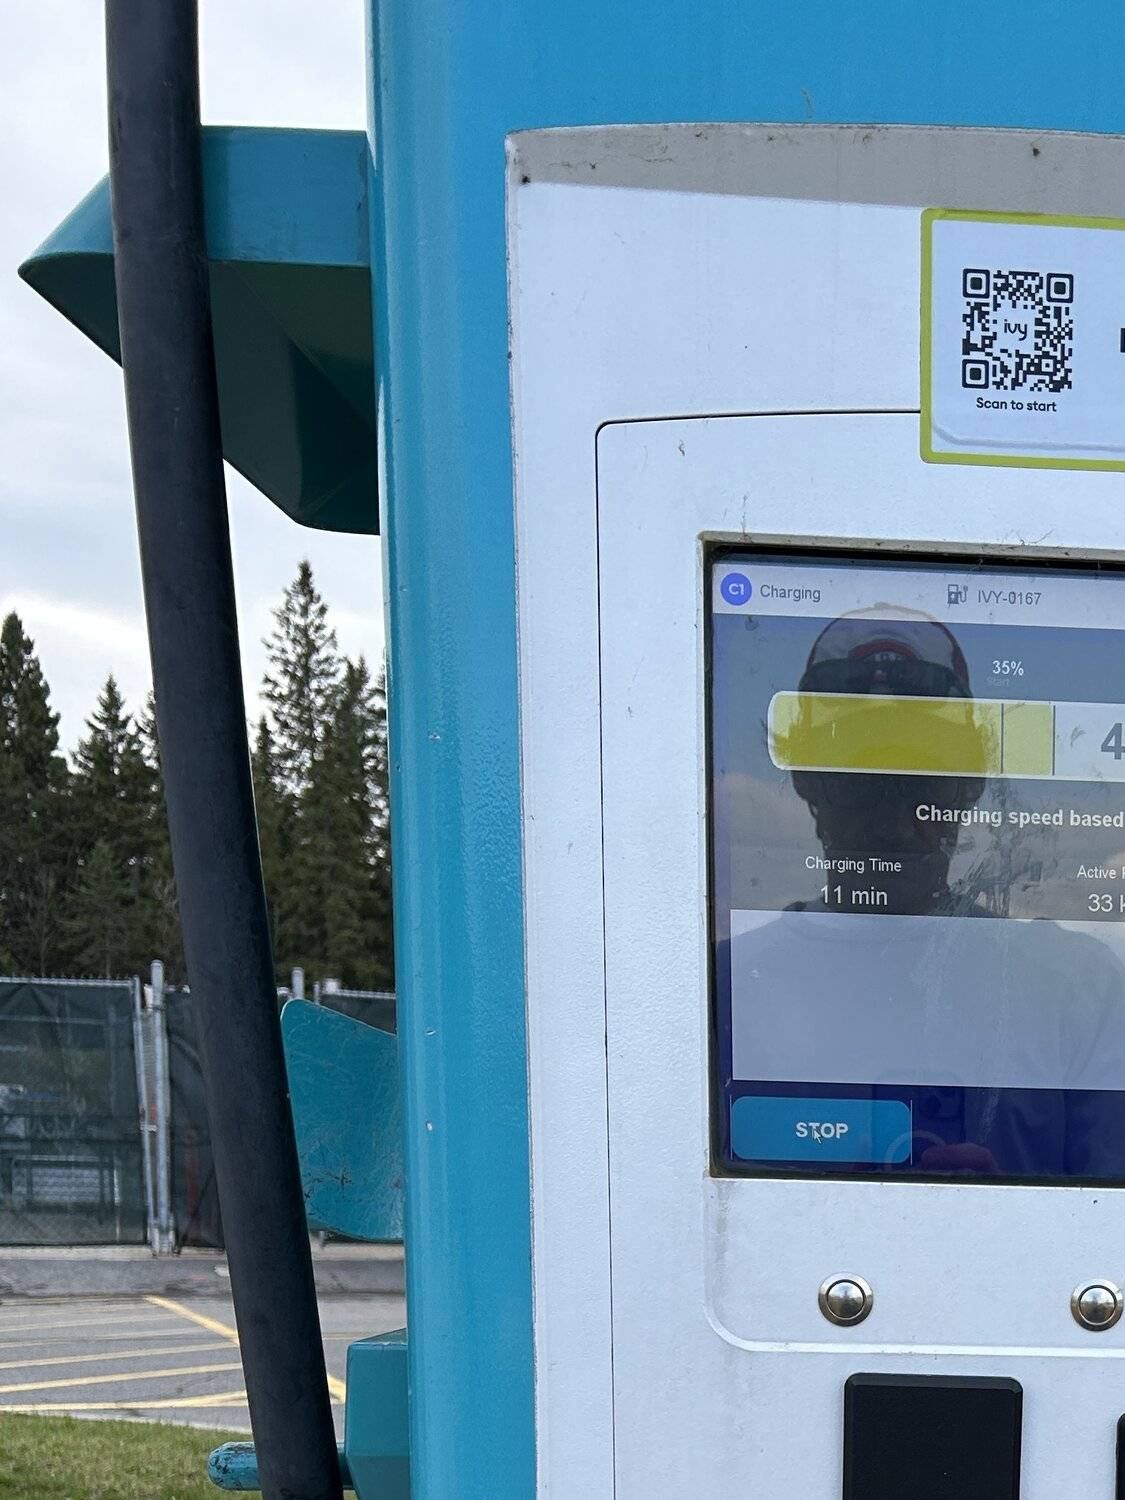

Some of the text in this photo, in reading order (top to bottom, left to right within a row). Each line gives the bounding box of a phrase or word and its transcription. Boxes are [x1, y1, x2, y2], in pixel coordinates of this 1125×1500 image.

[1003, 318, 1028, 342] ivy
[976, 397, 1057, 413] Scan to start
[728, 583, 745, 596] C1
[759, 584, 821, 602] Charging
[977, 590, 1042, 606] IVY-0167
[992, 660, 1024, 676] 35%
[915, 805, 1002, 827] Charging
[1008, 808, 1064, 829] speed
[1069, 809, 1125, 828] based
[804, 856, 902, 873] Charging Time
[1076, 865, 1117, 880] Active
[820, 885, 889, 906] 11 min
[1087, 893, 1114, 913] 33
[795, 1122, 849, 1139] STOP
